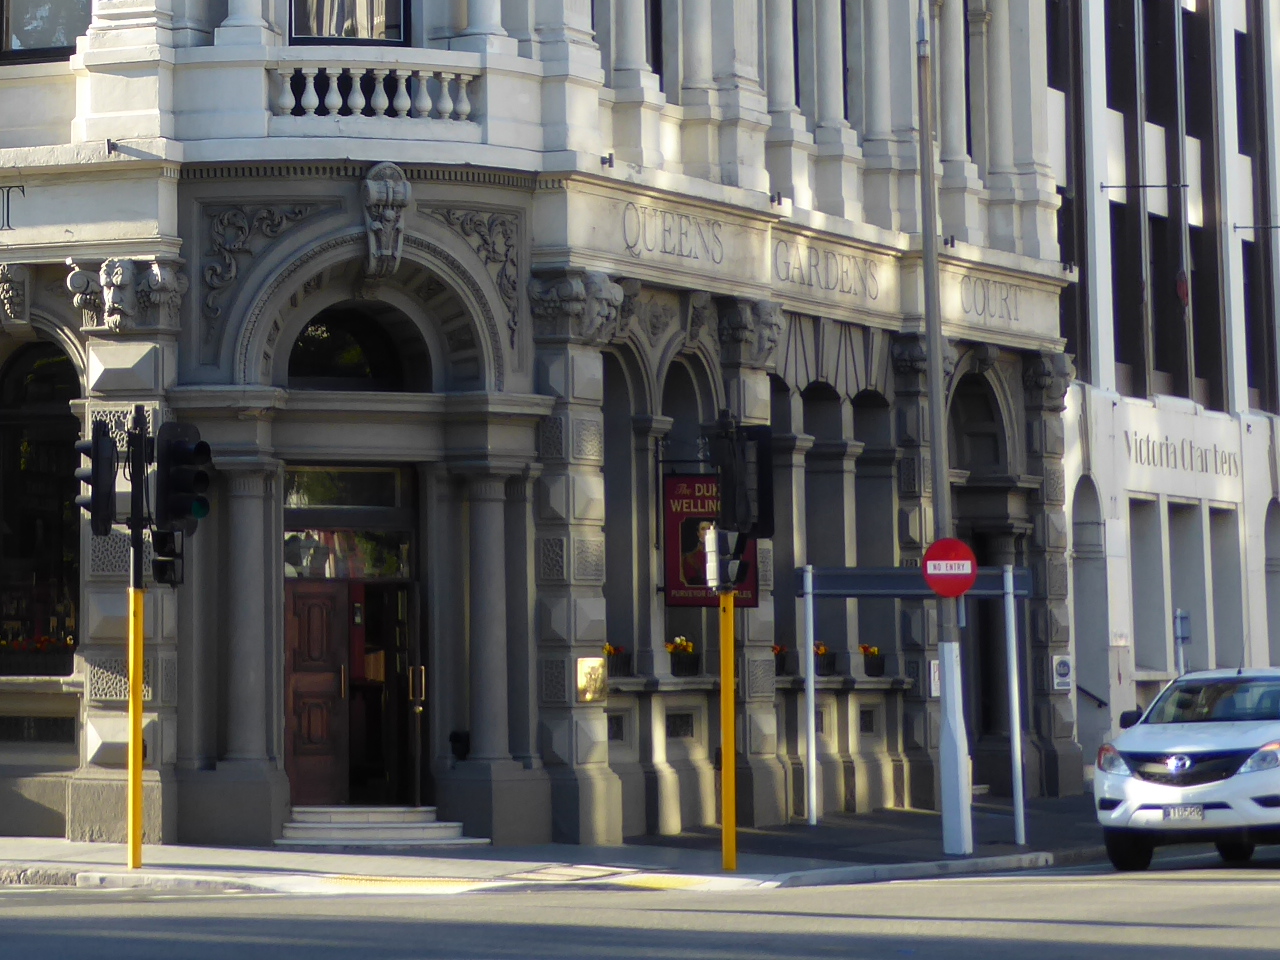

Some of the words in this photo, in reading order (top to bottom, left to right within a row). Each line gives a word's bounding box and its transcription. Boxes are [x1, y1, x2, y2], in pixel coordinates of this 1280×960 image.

[622, 201, 724, 265] QUEENS
[773, 240, 879, 301] GARDENS
[960, 274, 1022, 322] COURT
[1123, 430, 1178, 470] Victoria
[670, 499, 721, 512] WELLIN
[932, 562, 942, 572] NO
[945, 562, 966, 572] ENTRY
